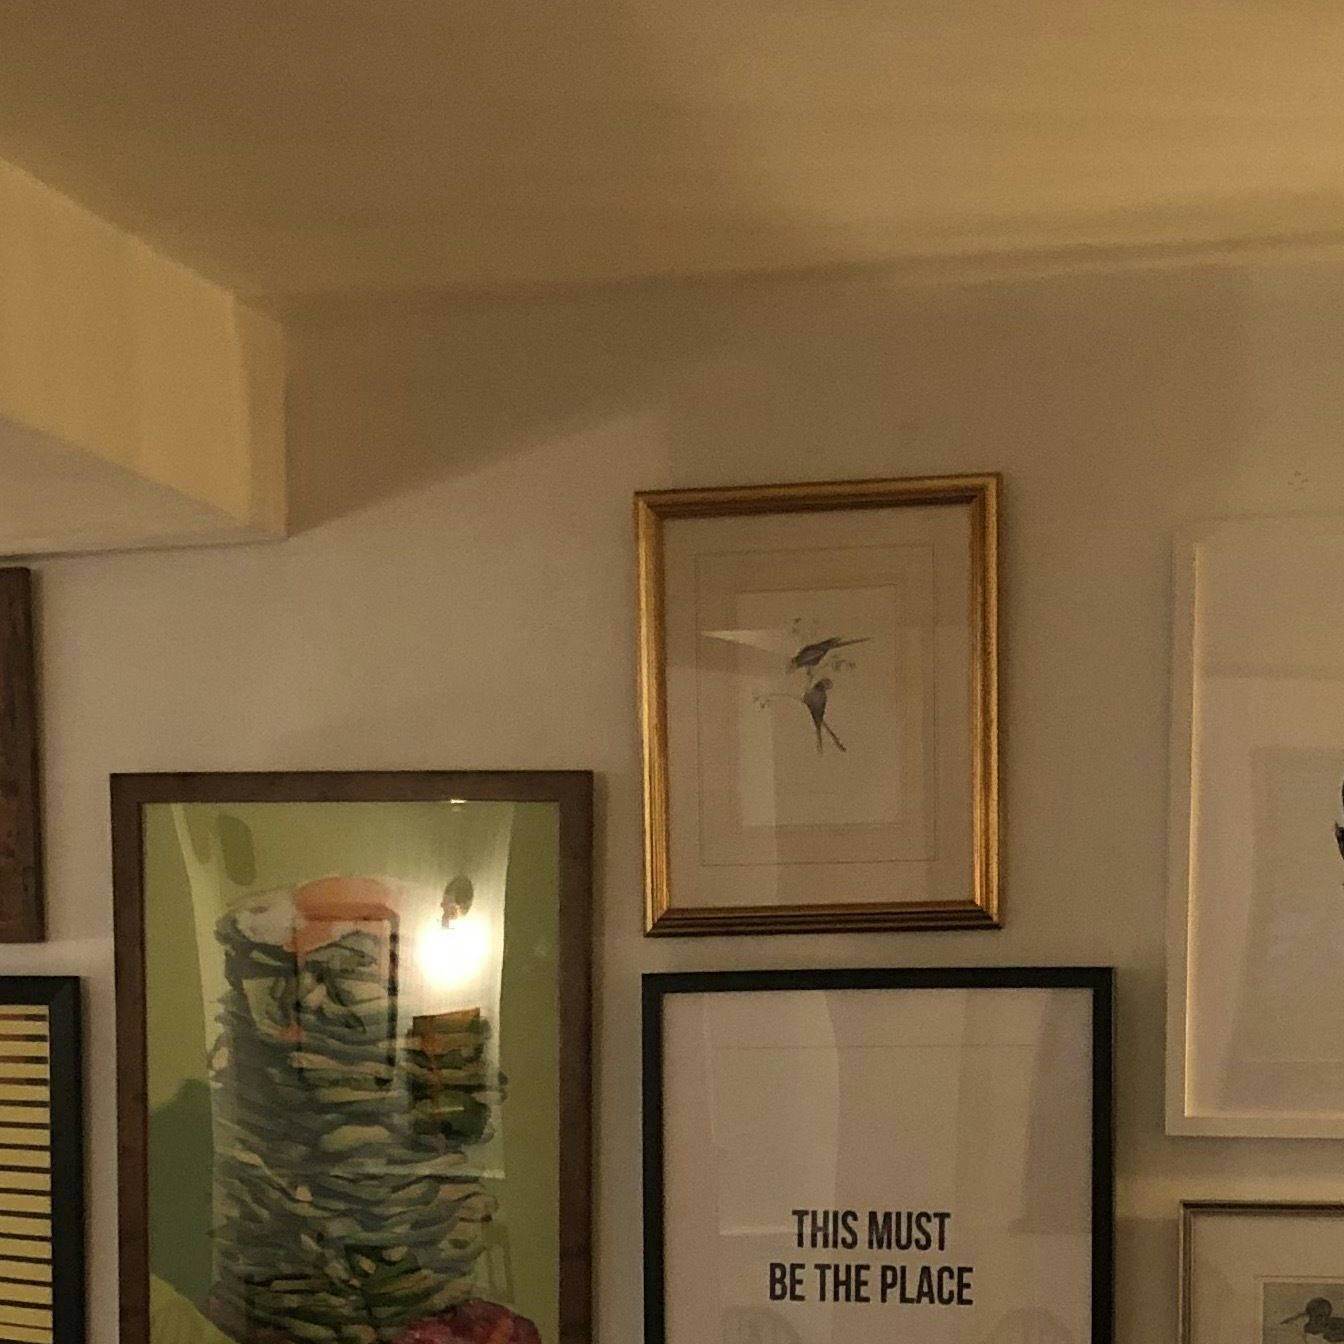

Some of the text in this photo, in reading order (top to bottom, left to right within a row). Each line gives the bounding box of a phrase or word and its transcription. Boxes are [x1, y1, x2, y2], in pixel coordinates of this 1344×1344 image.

[792, 1210, 951, 1251] THIS MUST
[769, 1262, 974, 1305] BE THE PLACE
